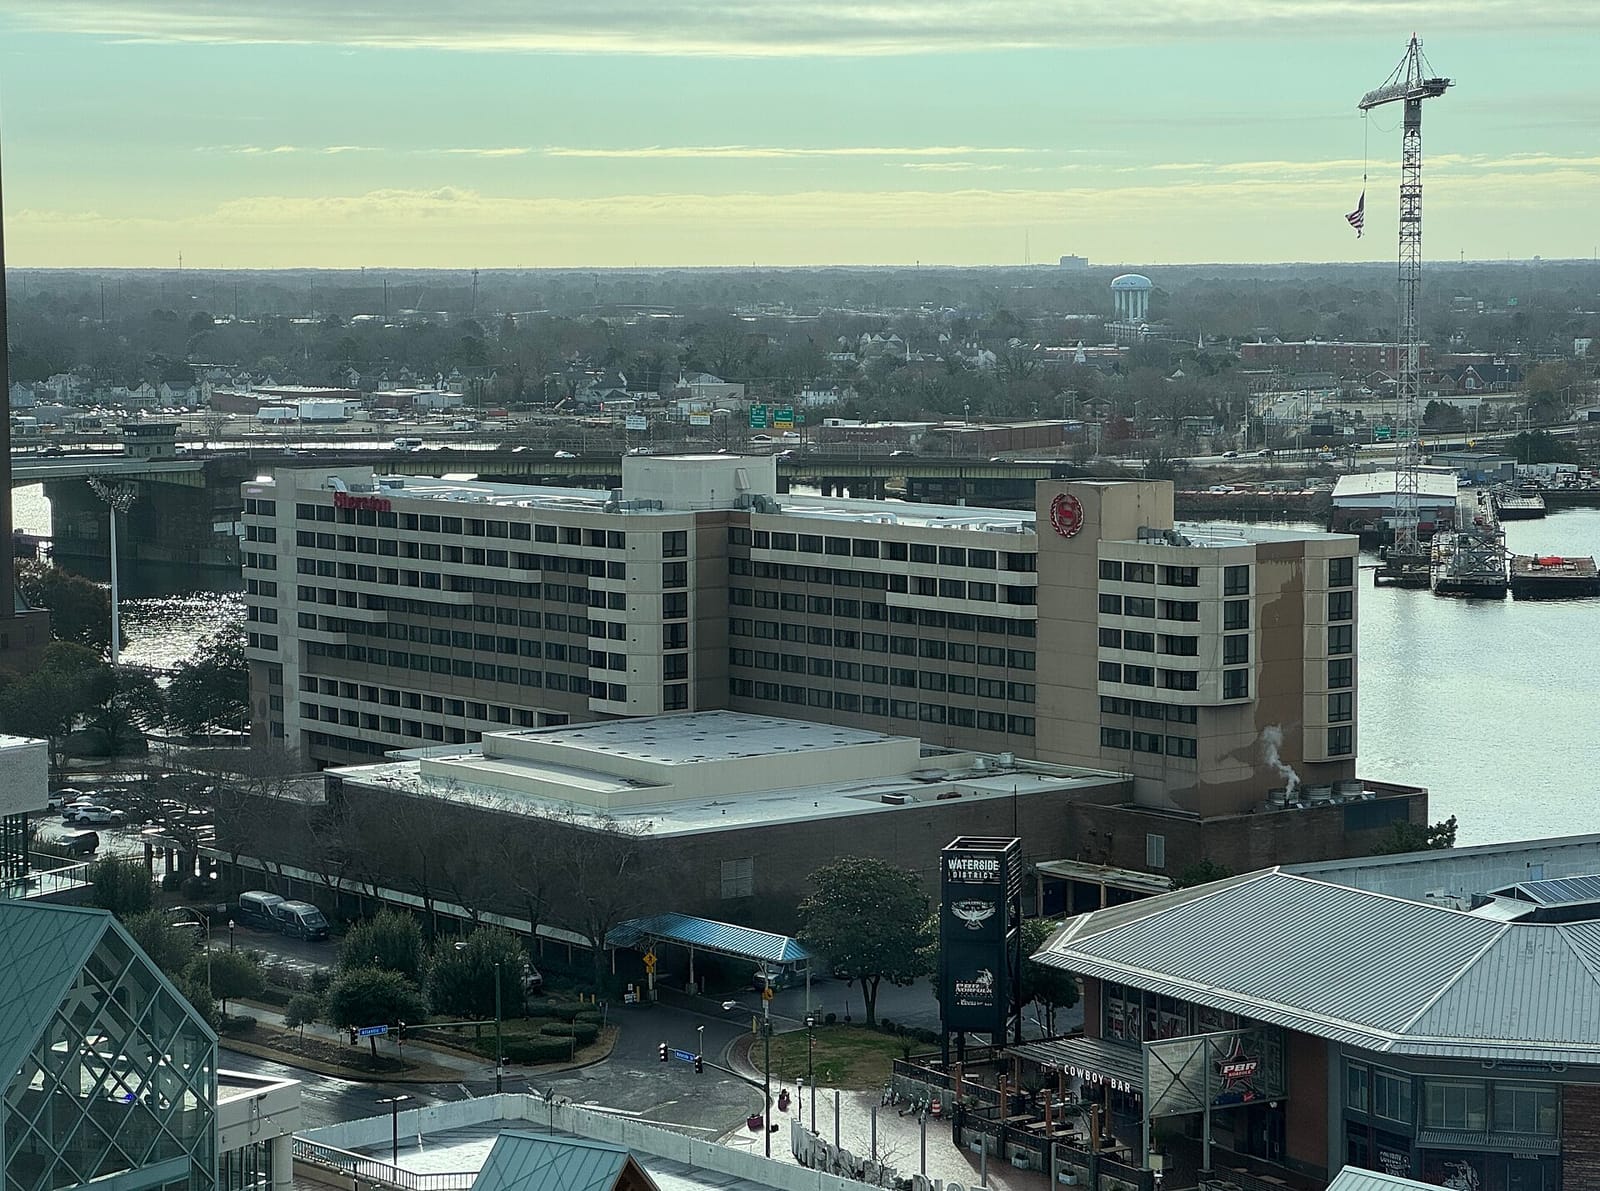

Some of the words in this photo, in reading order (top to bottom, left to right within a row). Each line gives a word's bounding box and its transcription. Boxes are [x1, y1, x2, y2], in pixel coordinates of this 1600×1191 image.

[948, 857, 1000, 871] WATERSIDE
[952, 871, 994, 879] DISTRICT
[1223, 1062, 1257, 1074] PBR
[1064, 1064, 1104, 1085] COWBOY
[1110, 1078, 1131, 1093] BAR
